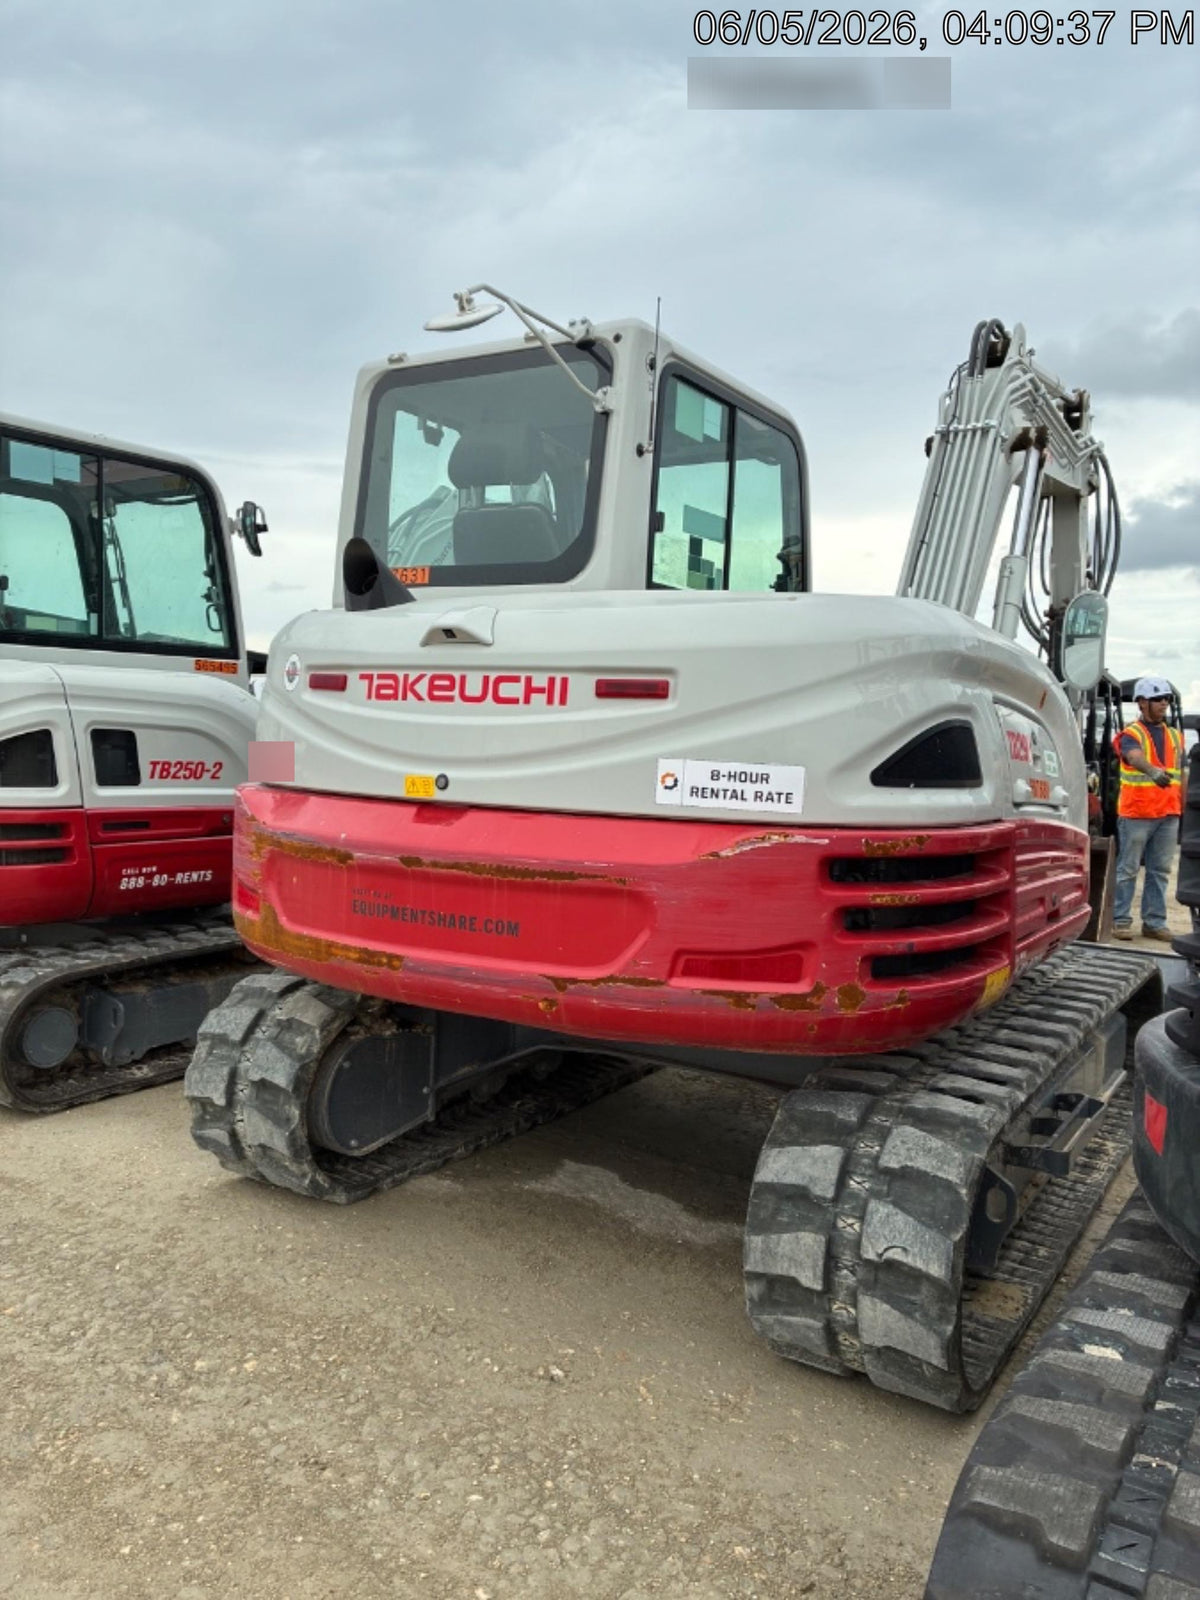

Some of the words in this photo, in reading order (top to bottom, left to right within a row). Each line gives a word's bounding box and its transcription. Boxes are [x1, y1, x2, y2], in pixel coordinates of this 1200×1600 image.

[149, 760, 223, 780] TB250-2
[710, 769, 771, 785] 8-HOUR
[689, 786, 748, 802] RENTAL
[753, 790, 794, 805] RATE
[120, 870, 213, 890] 888-80-RENTS
[352, 899, 520, 937] EQUIPMENTSHARE.COM
